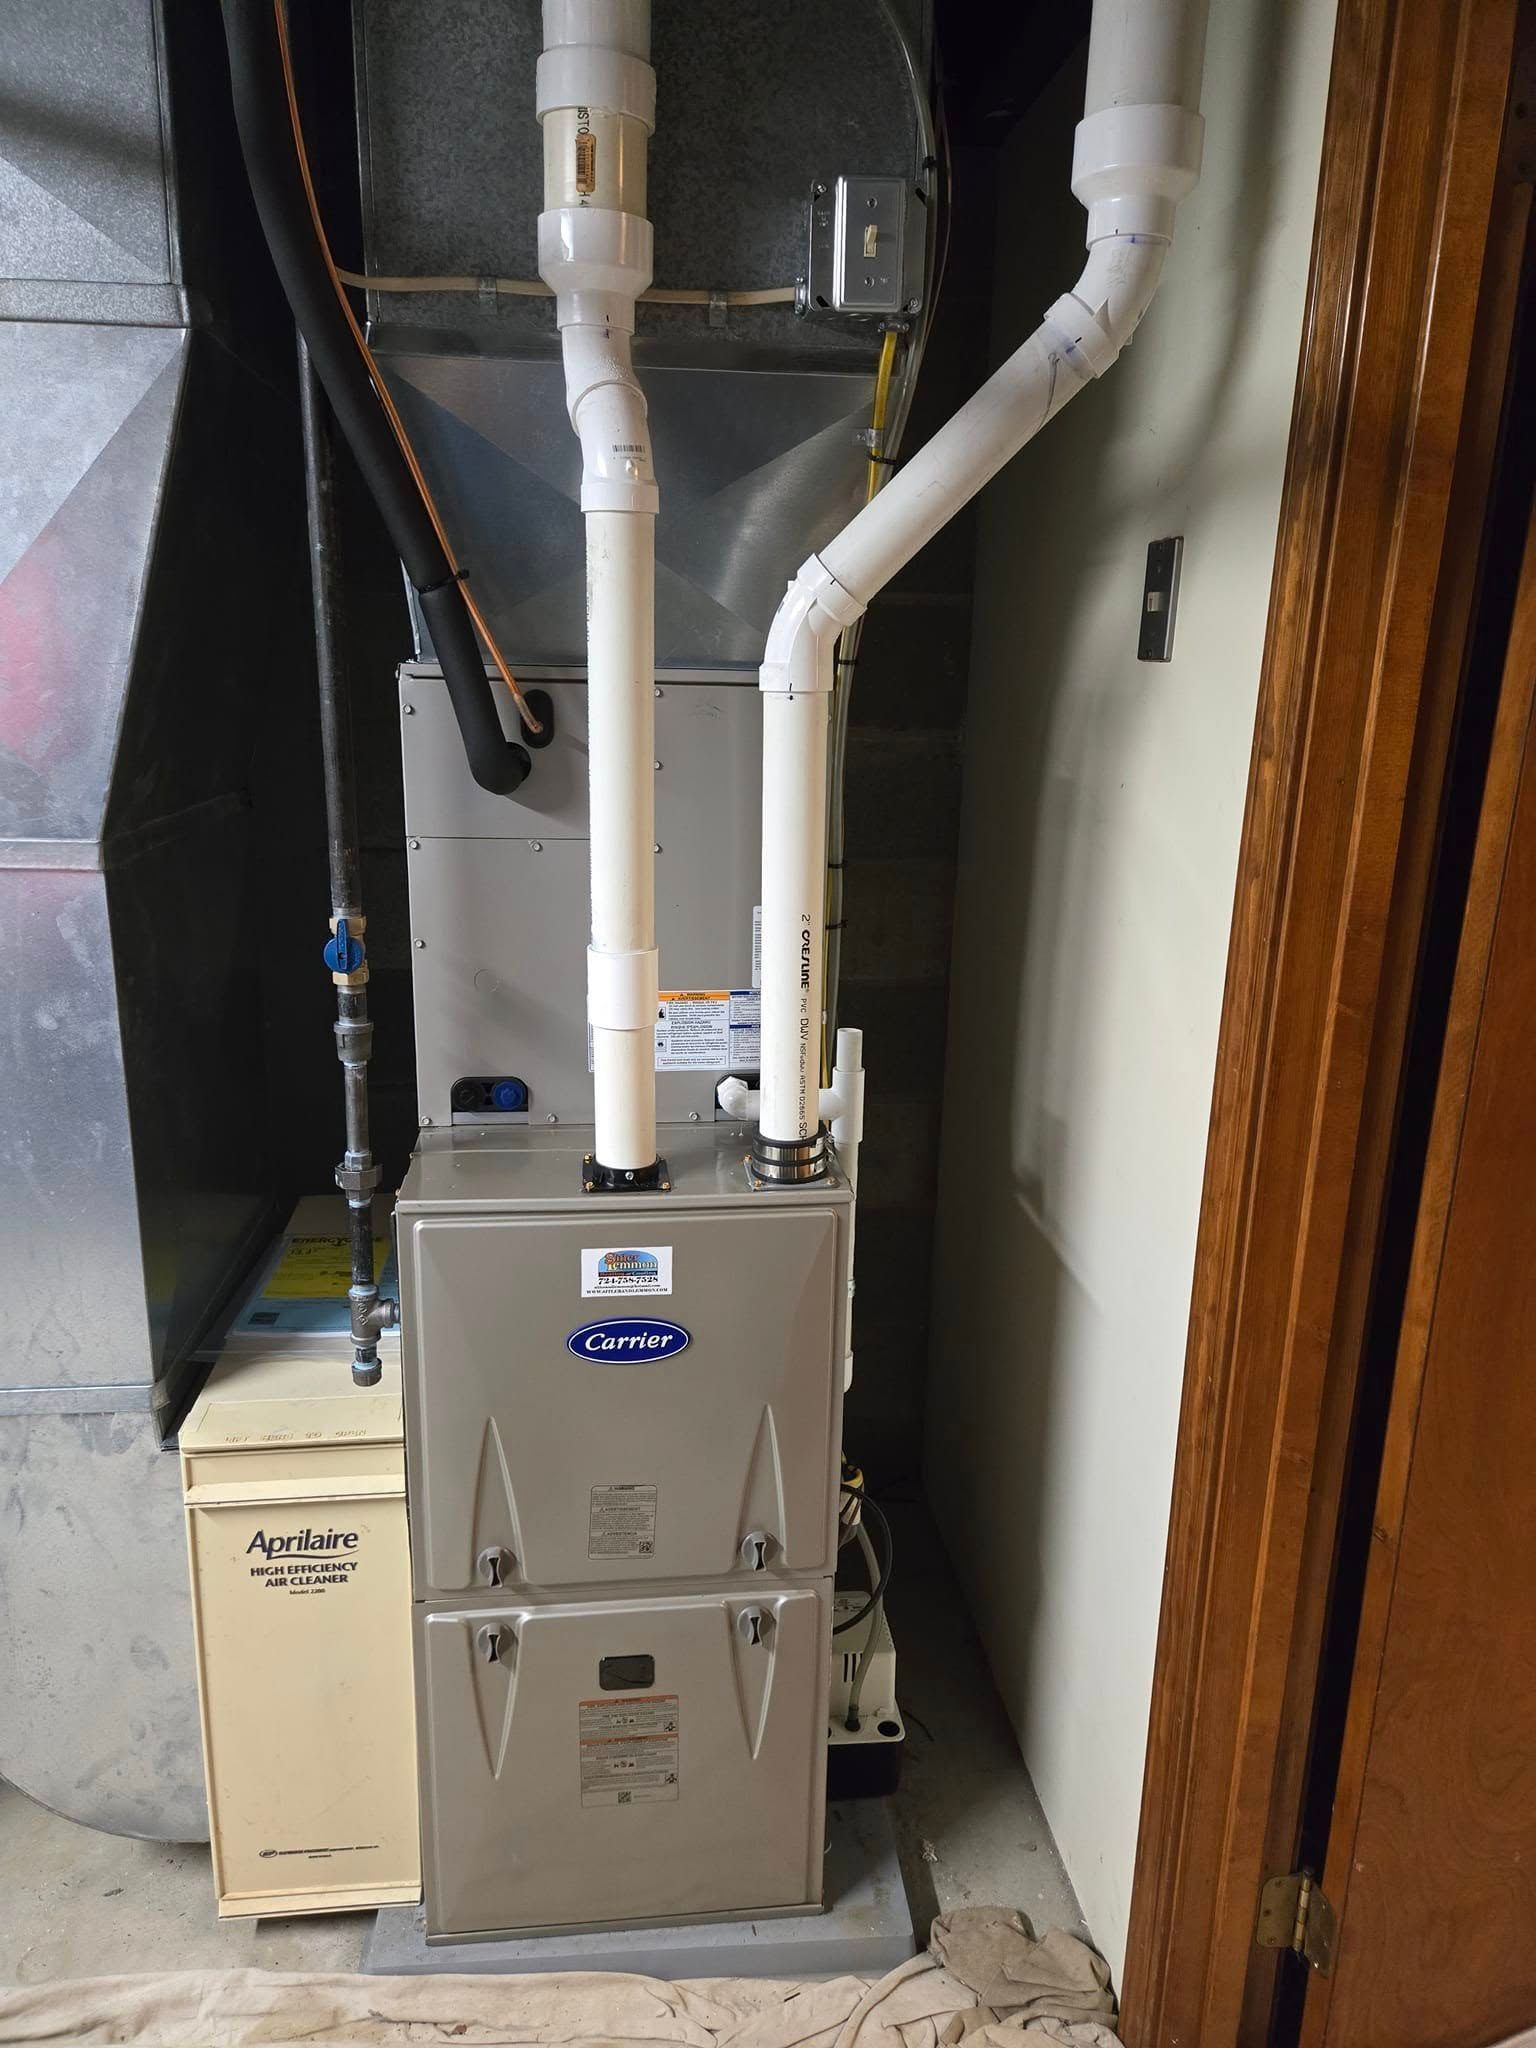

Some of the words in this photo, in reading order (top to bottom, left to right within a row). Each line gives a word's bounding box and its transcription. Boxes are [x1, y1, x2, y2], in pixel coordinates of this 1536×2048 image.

[799, 1018, 809, 1041] DWV
[585, 1332, 673, 1351] Carrier
[246, 1528, 359, 1560] Aprilaire
[250, 1565, 285, 1577] HIGH
[287, 1561, 359, 1575] EFFICIENCY
[265, 1577, 288, 1588] AIR
[290, 1574, 349, 1587] CLEANER
